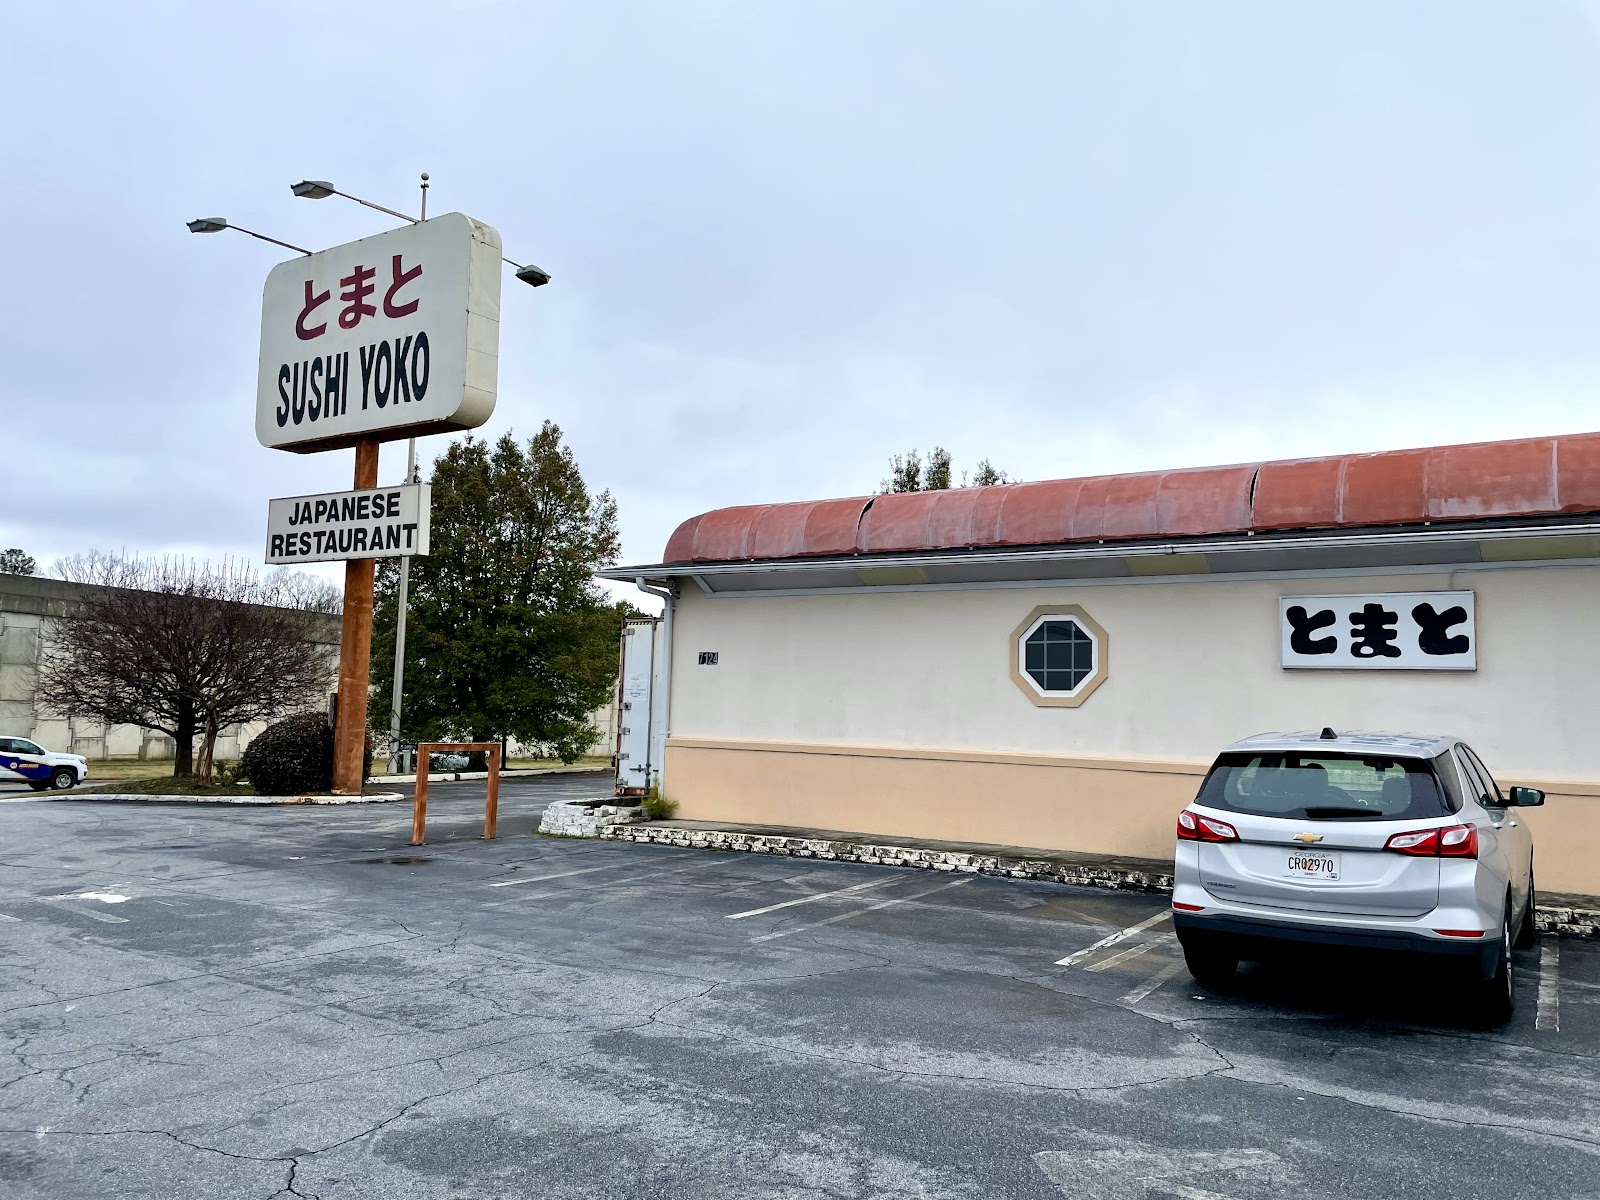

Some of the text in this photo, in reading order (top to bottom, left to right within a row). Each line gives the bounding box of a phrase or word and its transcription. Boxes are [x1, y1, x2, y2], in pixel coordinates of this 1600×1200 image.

[295, 254, 423, 341] とまと
[276, 331, 430, 428] SUSHI YOKO
[288, 491, 401, 526] JAPANESE
[270, 523, 418, 557] RESTAURANT
[1286, 602, 1470, 658] とまと
[699, 652, 718, 665] 7124
